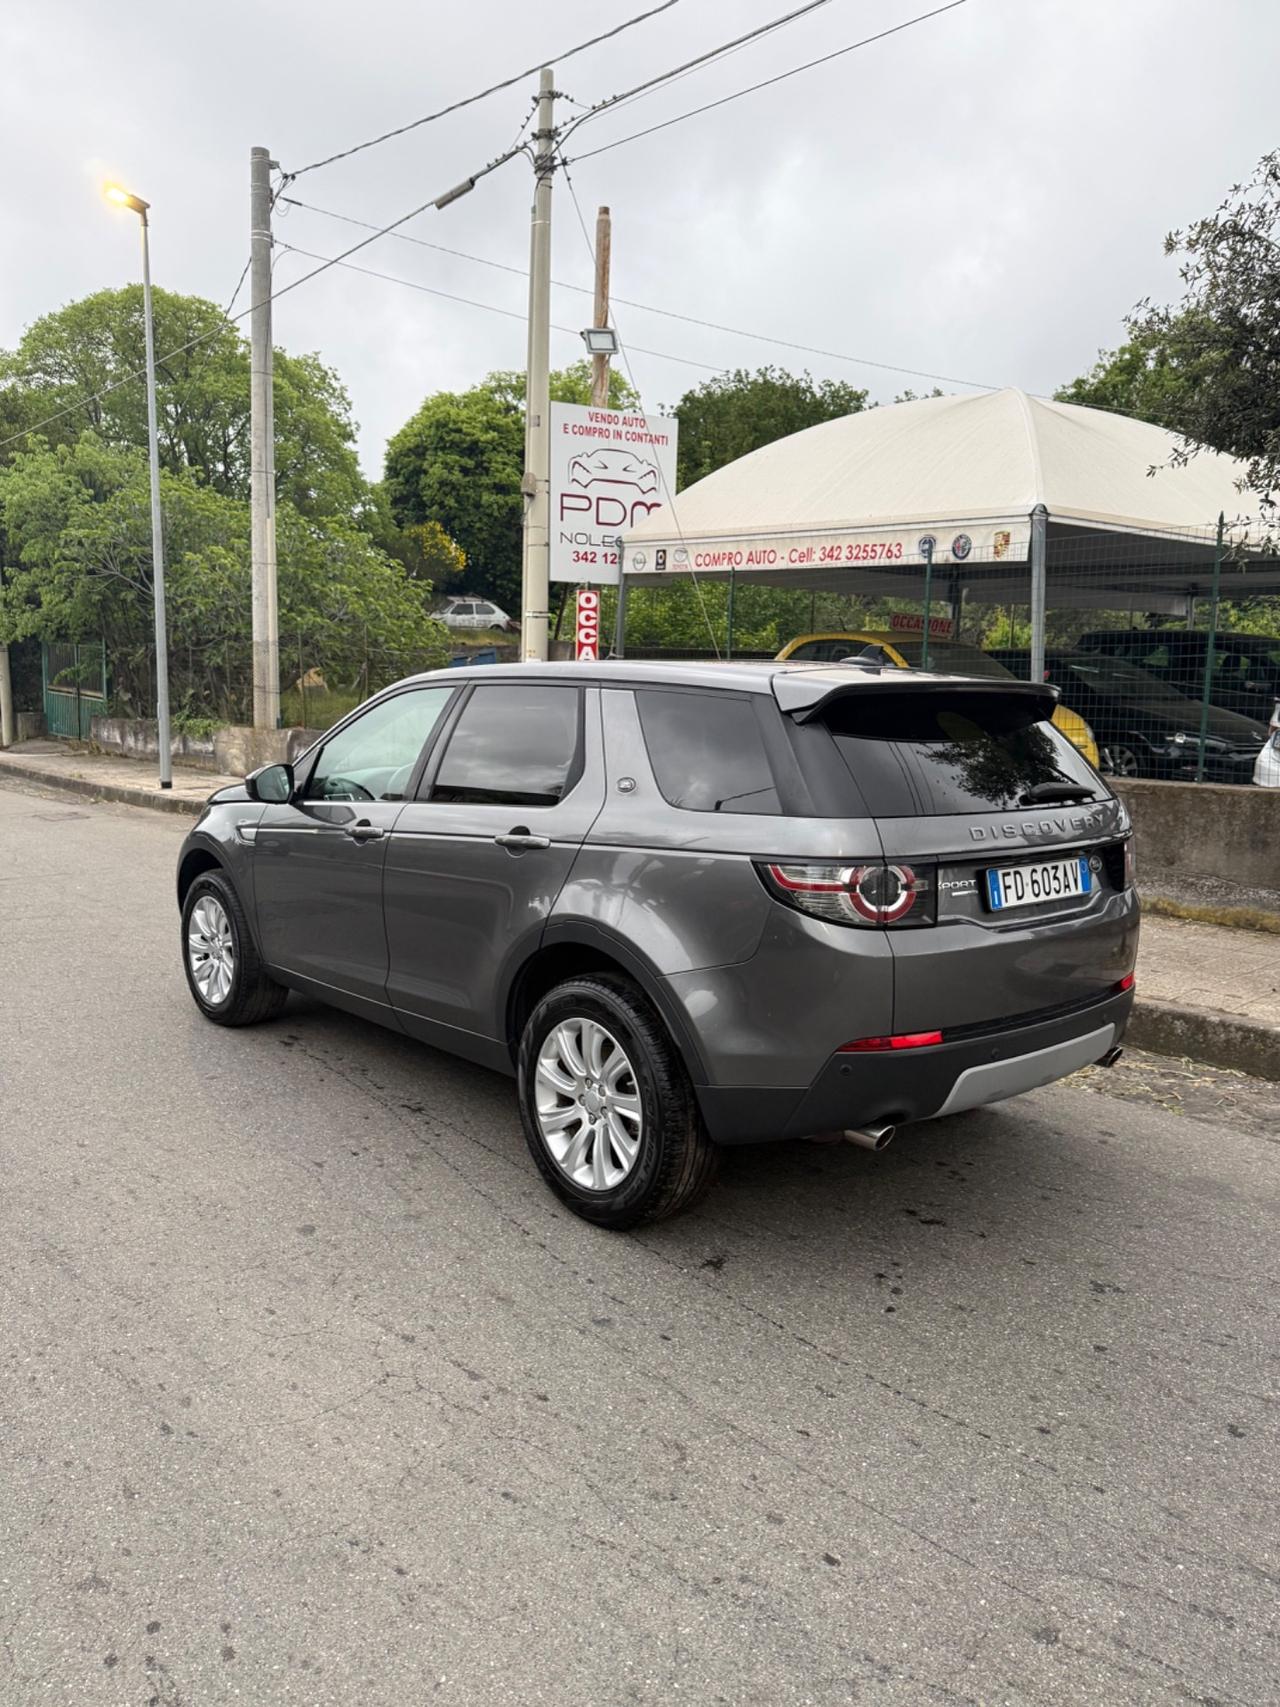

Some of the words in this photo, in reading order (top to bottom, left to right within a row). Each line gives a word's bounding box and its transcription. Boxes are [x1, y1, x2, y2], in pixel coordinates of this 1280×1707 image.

[588, 411, 619, 425] VENDO
[622, 416, 646, 428] AUTO
[563, 423, 569, 434] E
[572, 424, 611, 439] COMPRO
[613, 430, 622, 440] IN
[625, 431, 668, 446] CONTANTI
[572, 550, 597, 563] 342
[602, 553, 622, 565] 12
[695, 551, 743, 567] COMPRO
[746, 549, 777, 565] AUTO
[788, 548, 815, 564] Cell:
[819, 546, 842, 561] 342
[845, 542, 902, 560] 3255763
[579, 592, 597, 660] OCCA
[892, 615, 952, 633] OCCAIONE
[969, 814, 1104, 841] DISCOVERY
[1001, 870, 1025, 903] FD
[1030, 861, 1079, 898] 603AV
